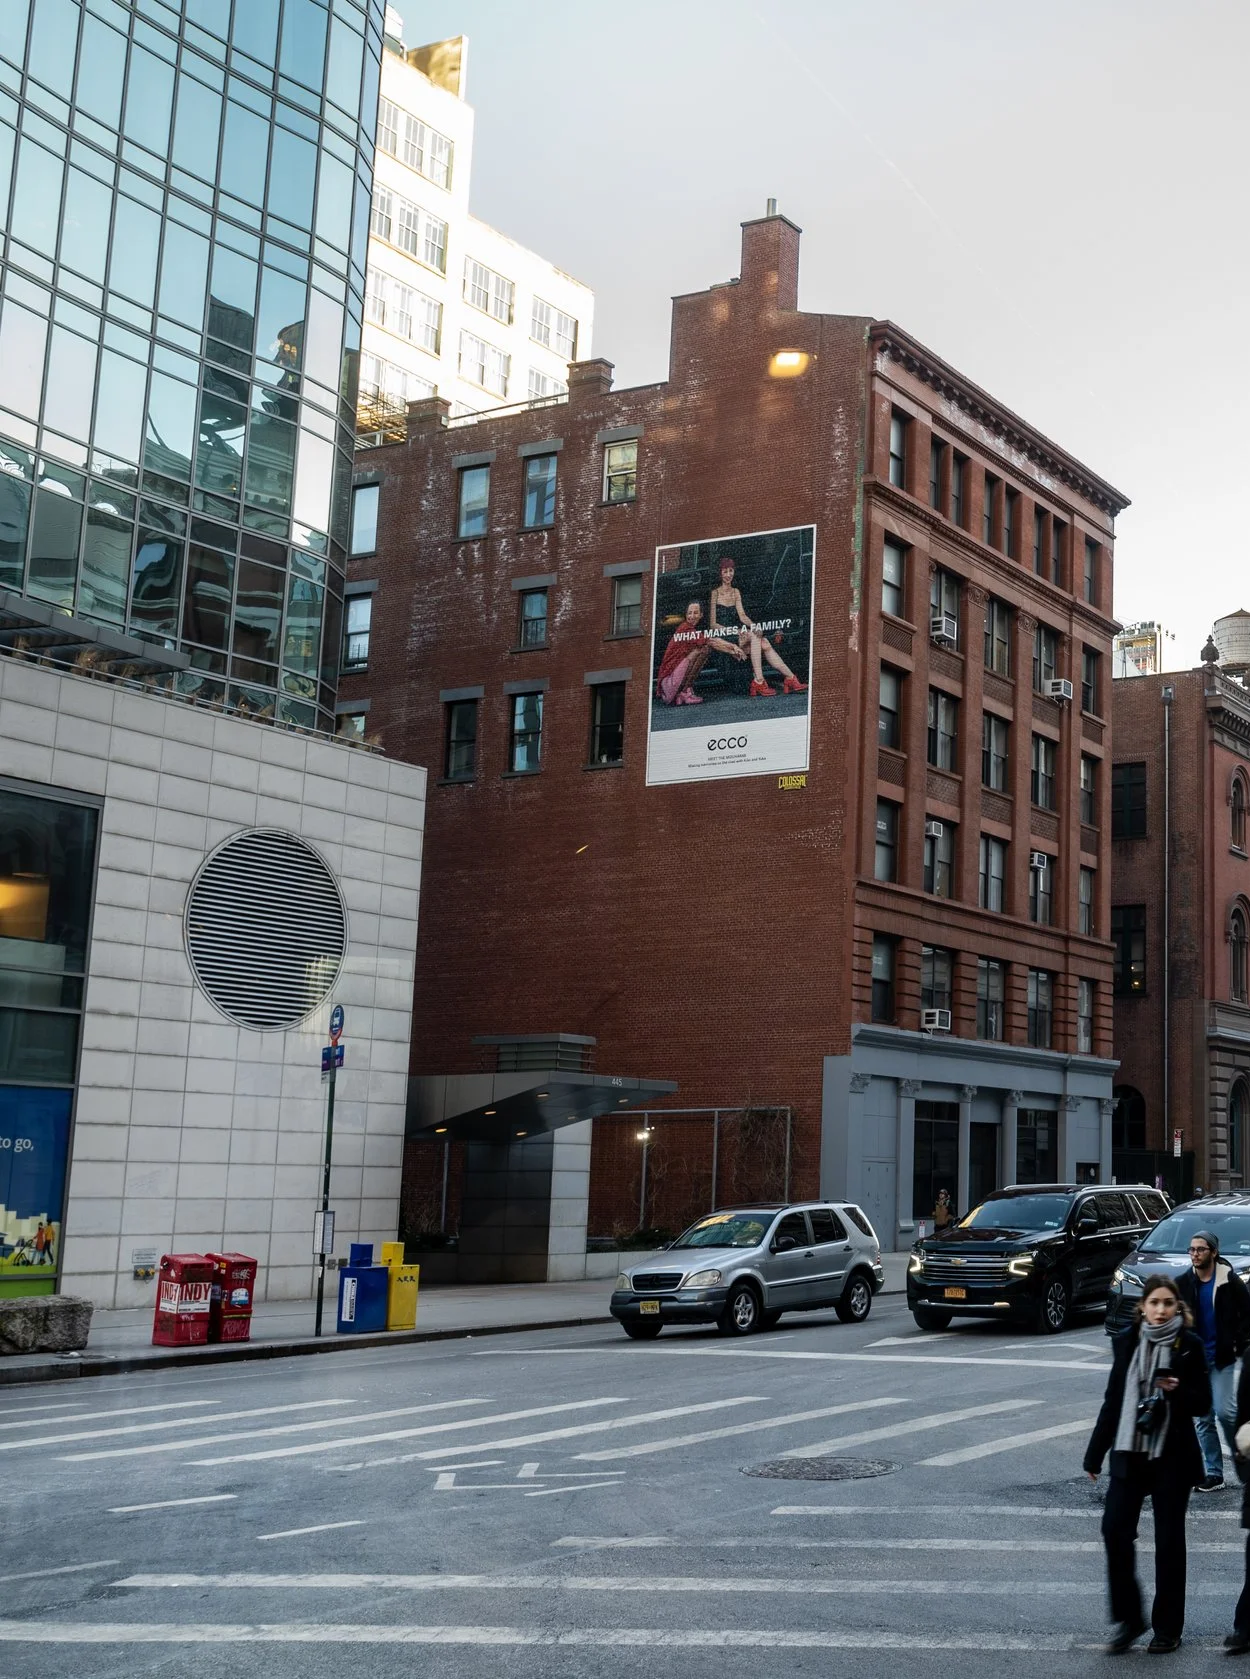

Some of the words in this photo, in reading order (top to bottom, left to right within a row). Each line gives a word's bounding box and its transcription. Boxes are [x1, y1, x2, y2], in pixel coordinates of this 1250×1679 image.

[673, 630, 702, 642] WHAT
[704, 625, 739, 639] MAKES
[740, 624, 748, 634] A
[750, 618, 792, 632] FAMILY?
[707, 736, 748, 751] ecco
[778, 775, 807, 789] COLOSSAL
[14, 1138, 34, 1152] go,
[180, 1283, 211, 1301] INDY
